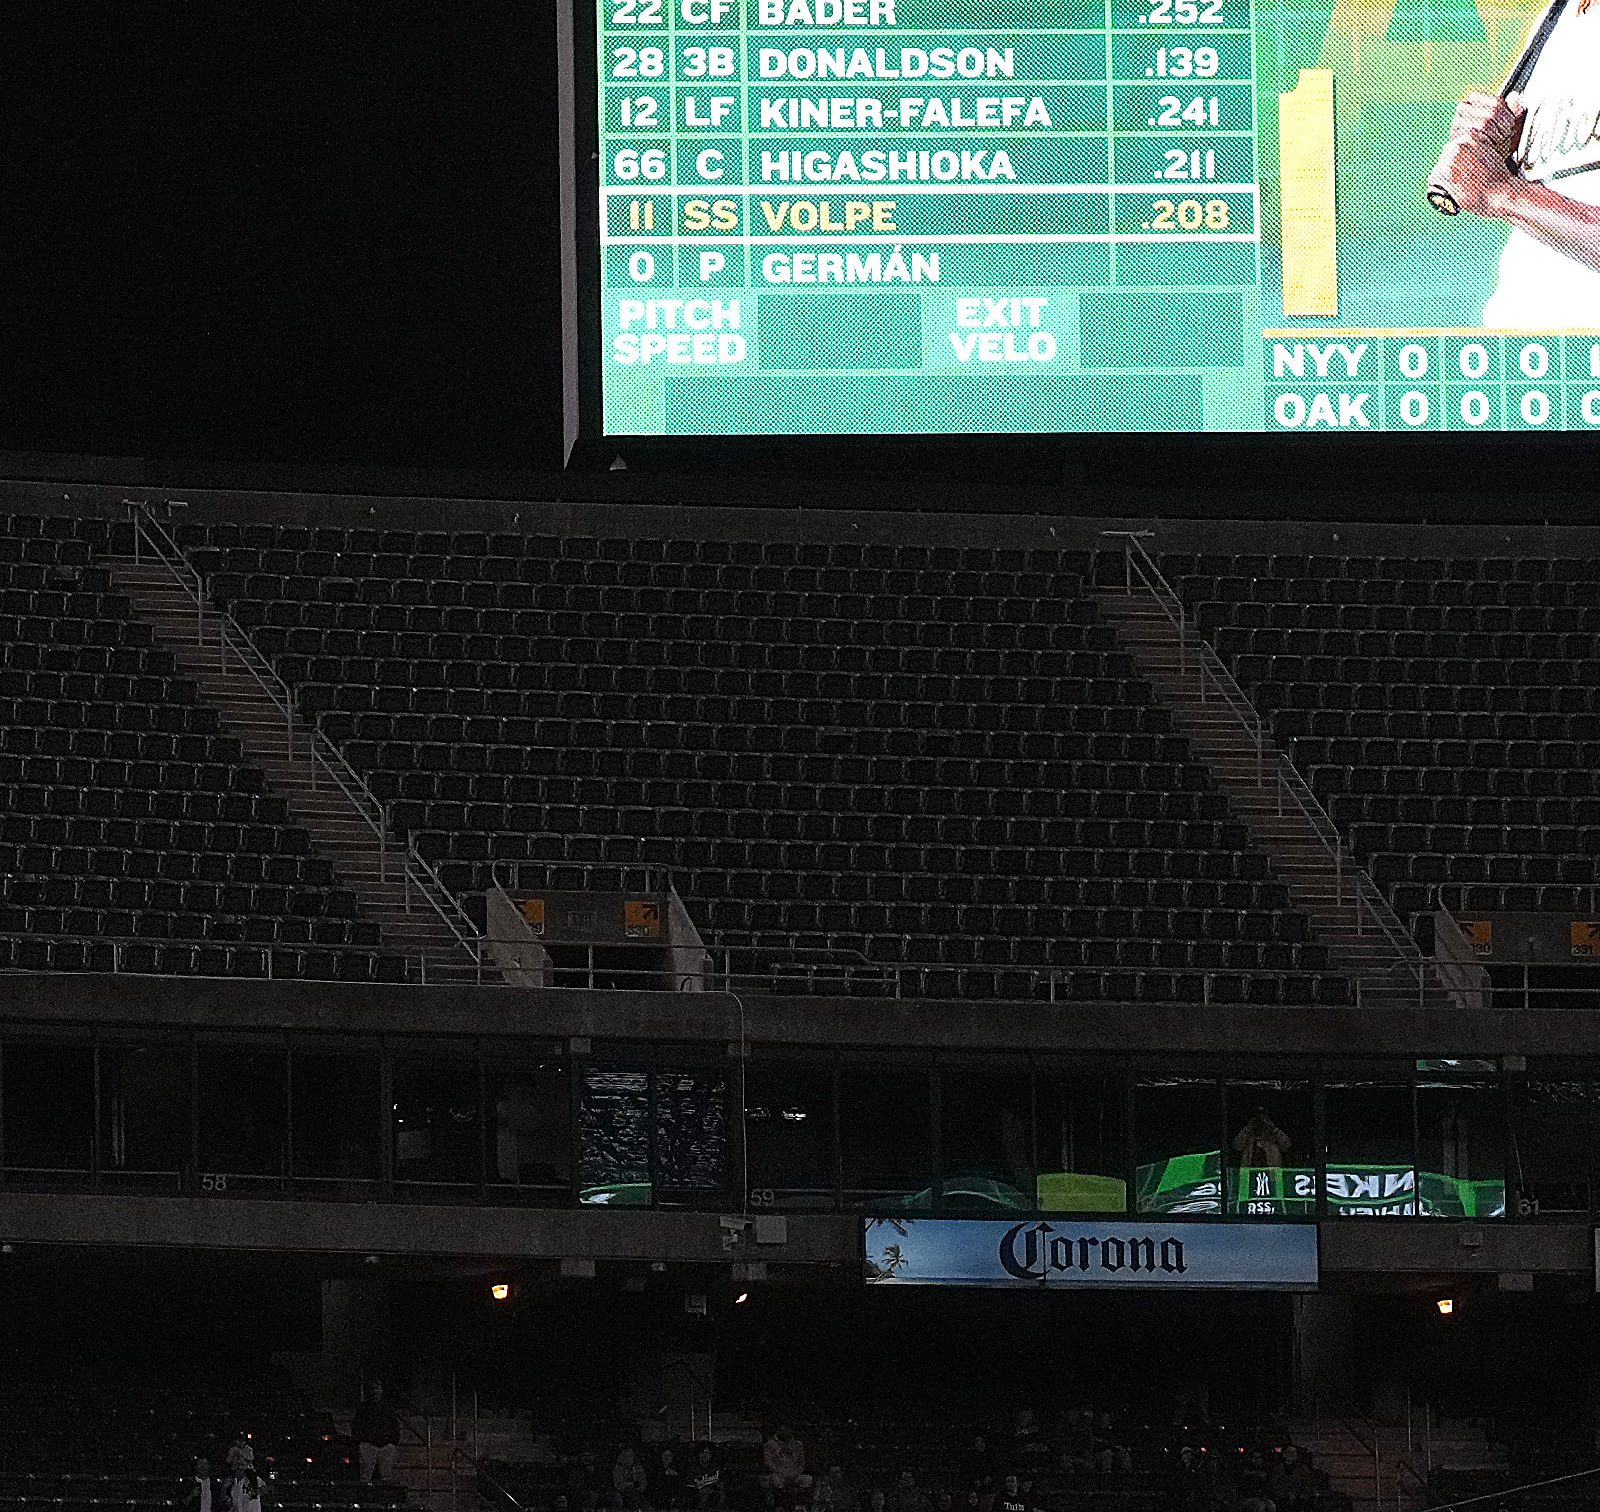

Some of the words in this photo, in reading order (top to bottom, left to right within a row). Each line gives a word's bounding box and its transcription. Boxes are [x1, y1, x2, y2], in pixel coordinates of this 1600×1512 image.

[612, 0, 664, 25] 22
[680, 0, 739, 25] CF
[759, 0, 896, 26] BADER
[1138, 0, 1224, 25] .252
[612, 48, 664, 77] 28
[683, 48, 735, 77] 3B
[759, 48, 1014, 78] DONALDSON
[1145, 47, 1219, 77] .139
[621, 97, 658, 126] 12
[685, 97, 735, 127] LF
[761, 98, 1052, 129] KINER-FALEFA
[1148, 96, 1219, 126] .241
[614, 151, 666, 180] 66
[695, 151, 725, 180] C
[762, 150, 1016, 182] HIGASHIOKA
[1153, 149, 1215, 179] .211
[683, 200, 738, 231] SS
[762, 200, 897, 231] VOLPE
[1142, 199, 1230, 230] .208
[700, 251, 726, 282] P
[763, 245, 940, 283] GERMÁN
[618, 299, 740, 330] PITCH
[956, 298, 1048, 328] EXIT
[613, 333, 746, 364] SPEED
[948, 333, 1056, 362] VELO
[1273, 344, 1368, 378] NYY
[1273, 393, 1371, 427] OAK
[202, 1175, 228, 1192] 58
[999, 1221, 1188, 1286] Corona
